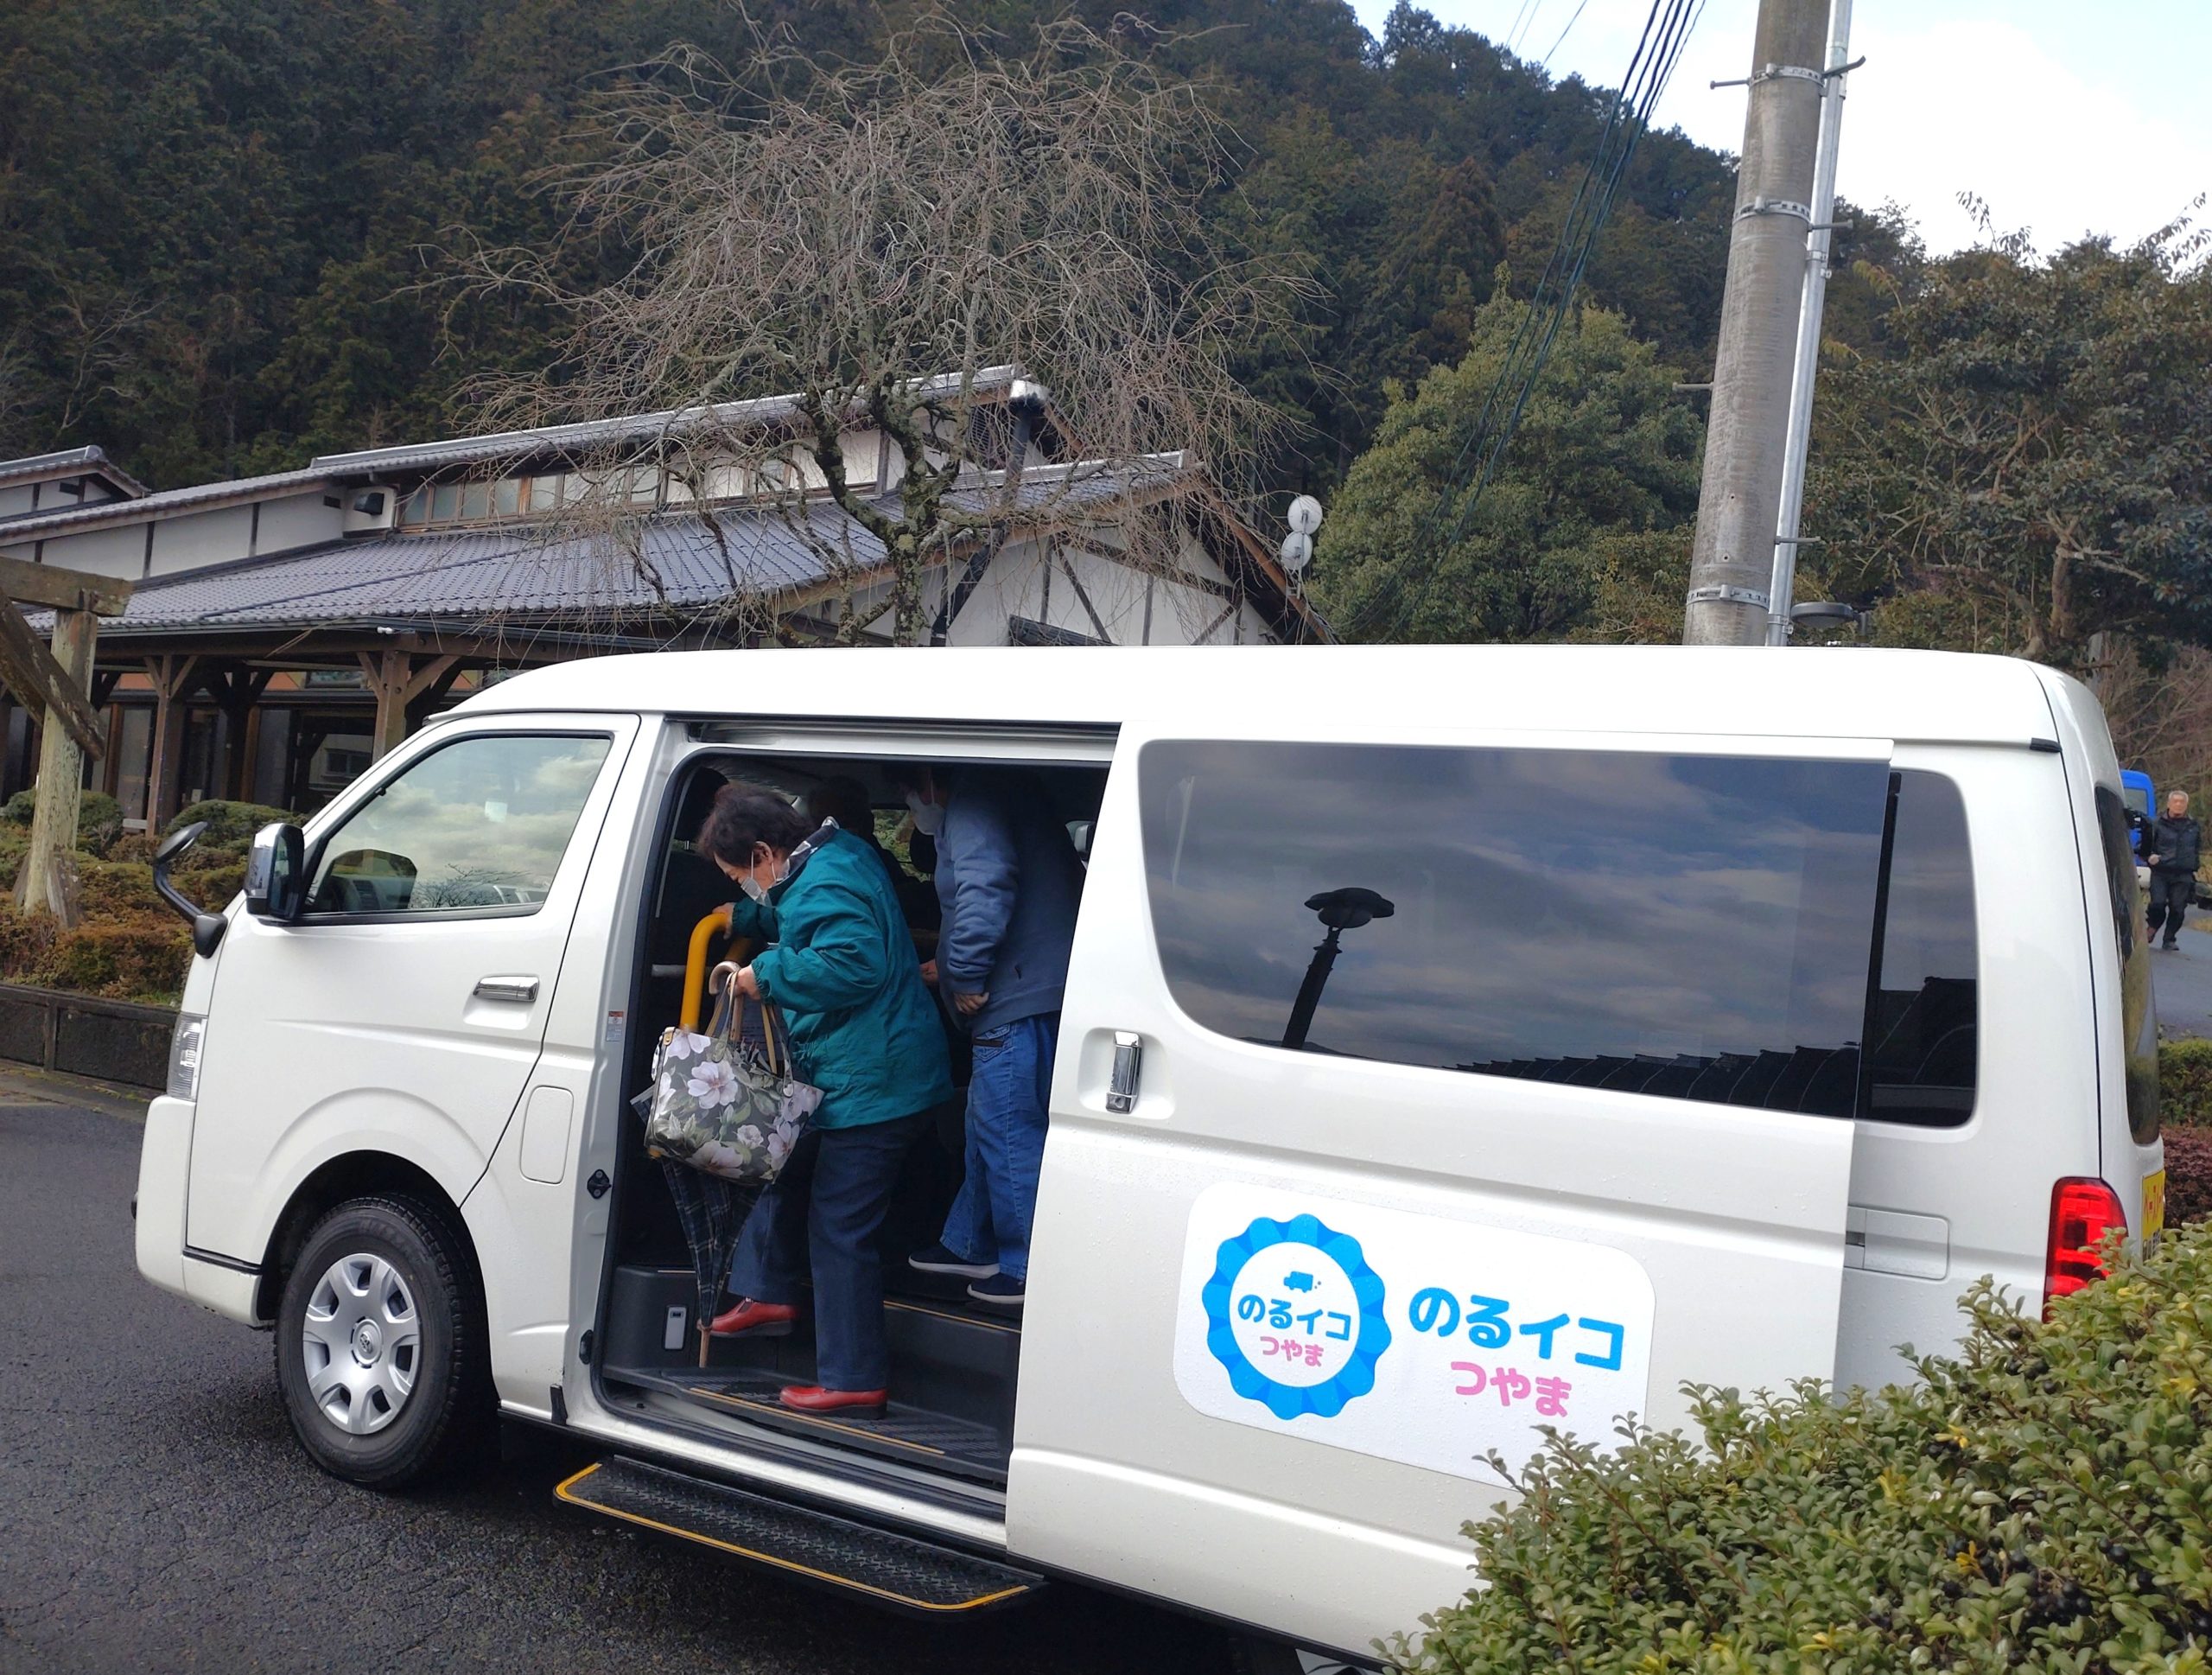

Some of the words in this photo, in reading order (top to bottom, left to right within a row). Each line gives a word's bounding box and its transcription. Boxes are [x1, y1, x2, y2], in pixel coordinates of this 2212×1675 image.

[1237, 1294, 1351, 1341] のるイコ
[1408, 1287, 1624, 1371] のるイコ
[1260, 1336, 1324, 1366] つやま
[1451, 1361, 1572, 1417] つやま
